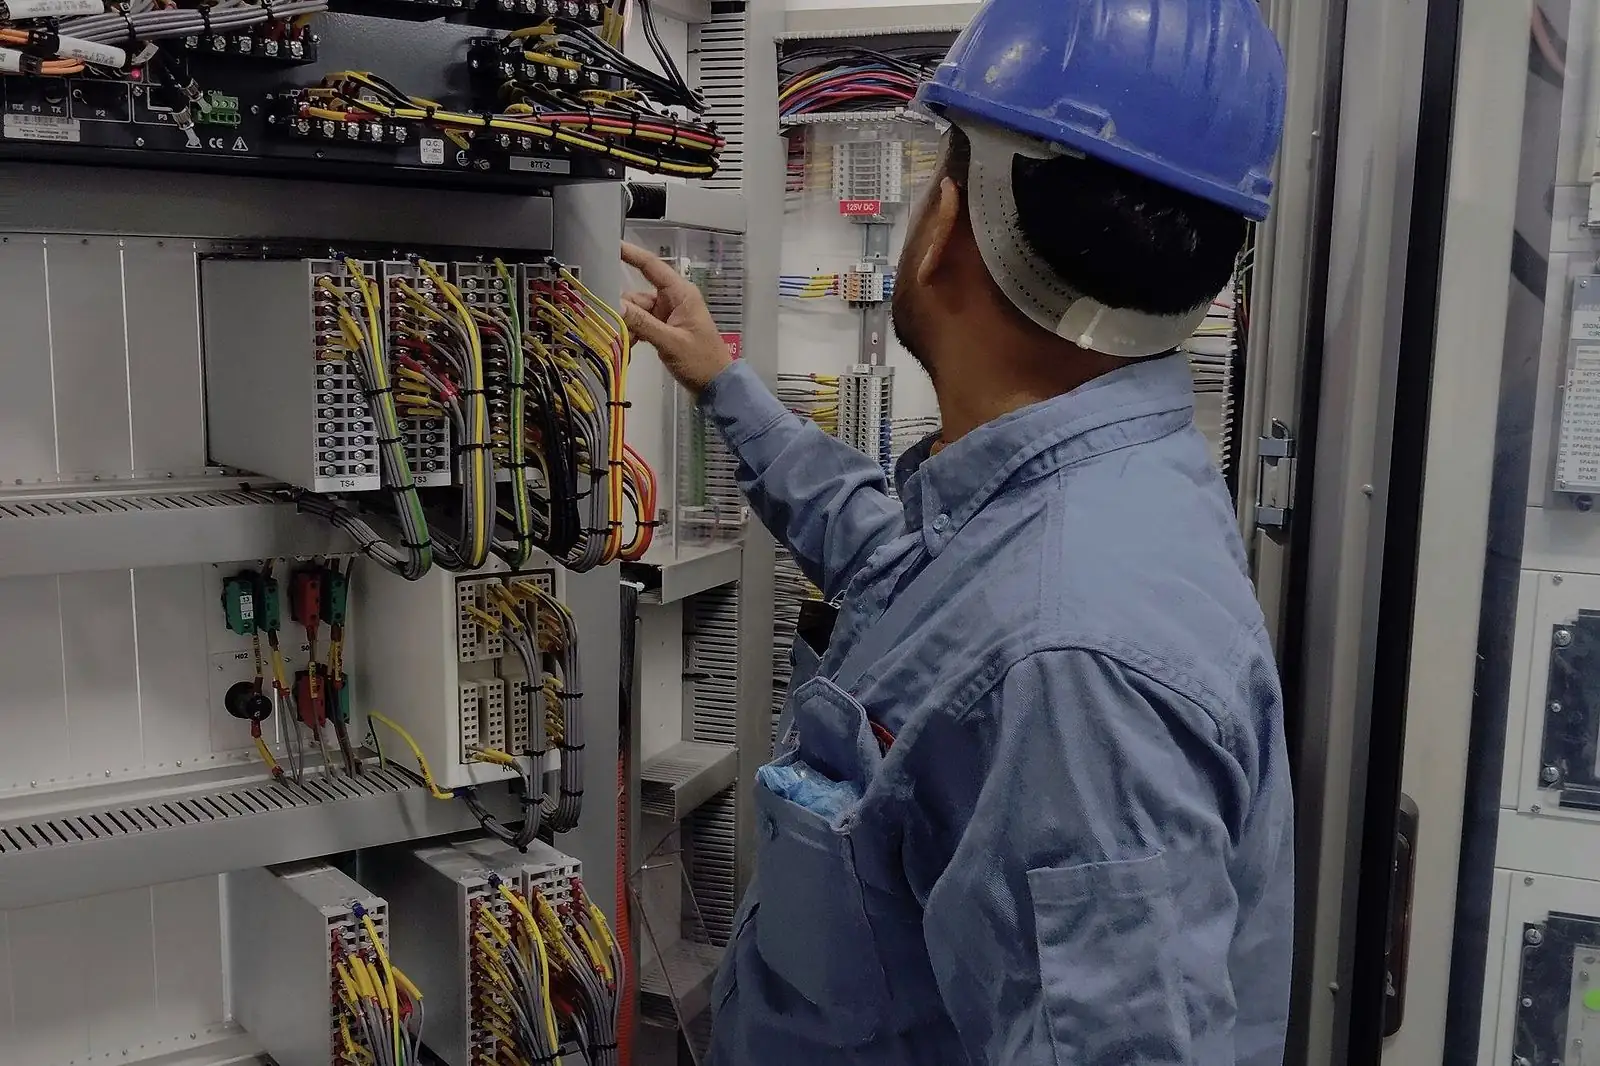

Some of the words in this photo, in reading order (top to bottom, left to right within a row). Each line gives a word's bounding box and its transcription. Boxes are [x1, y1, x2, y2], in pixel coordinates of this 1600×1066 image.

[12, 103, 24, 111] RX
[208, 137, 224, 149] CE
[530, 160, 551, 170] 87T-2
[846, 203, 862, 211] 125V
[863, 203, 874, 211] DC
[340, 480, 355, 488] TS4
[412, 476, 428, 484] TS3
[234, 652, 249, 660] H02
